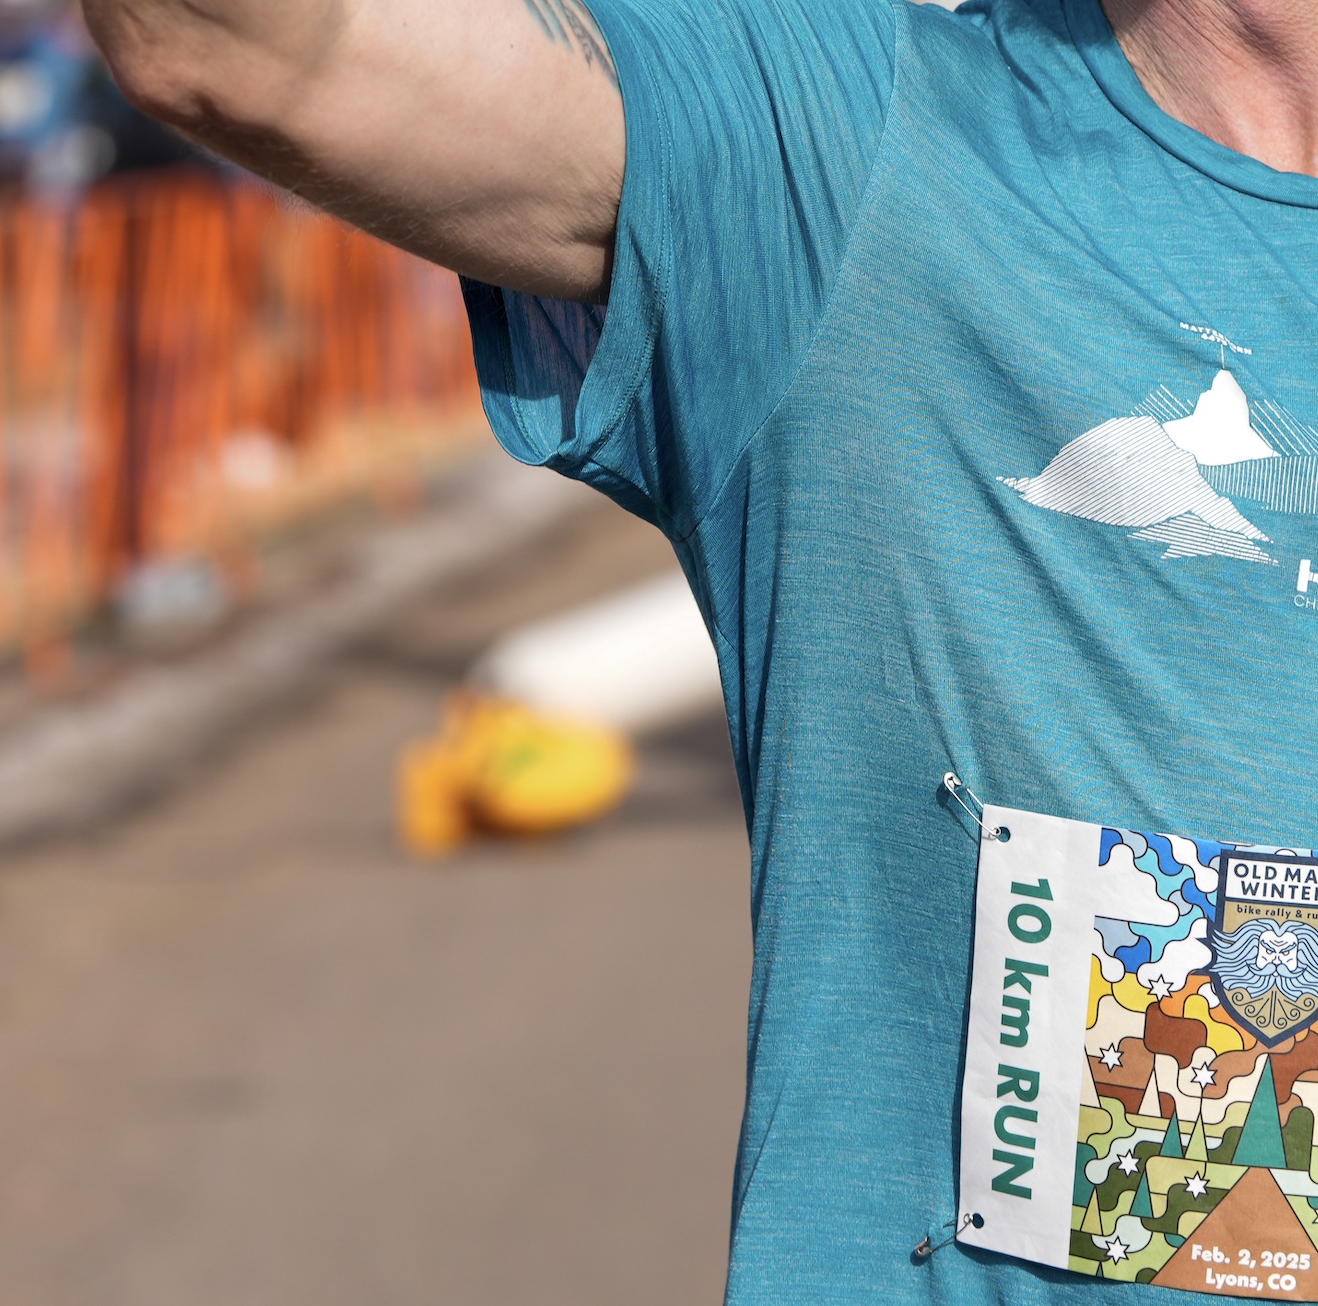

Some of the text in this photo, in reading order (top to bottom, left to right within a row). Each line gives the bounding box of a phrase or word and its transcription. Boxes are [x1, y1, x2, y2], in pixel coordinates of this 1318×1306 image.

[1234, 863, 1277, 881] OLD
[1237, 904, 1261, 915] bike
[1265, 908, 1291, 919] rally
[1295, 910, 1303, 918] &
[991, 878, 1054, 1200] 10 km RUN
[1191, 1244, 1311, 1270] Feb. 2, 2025
[1205, 1268, 1296, 1291] Lyons, CO
